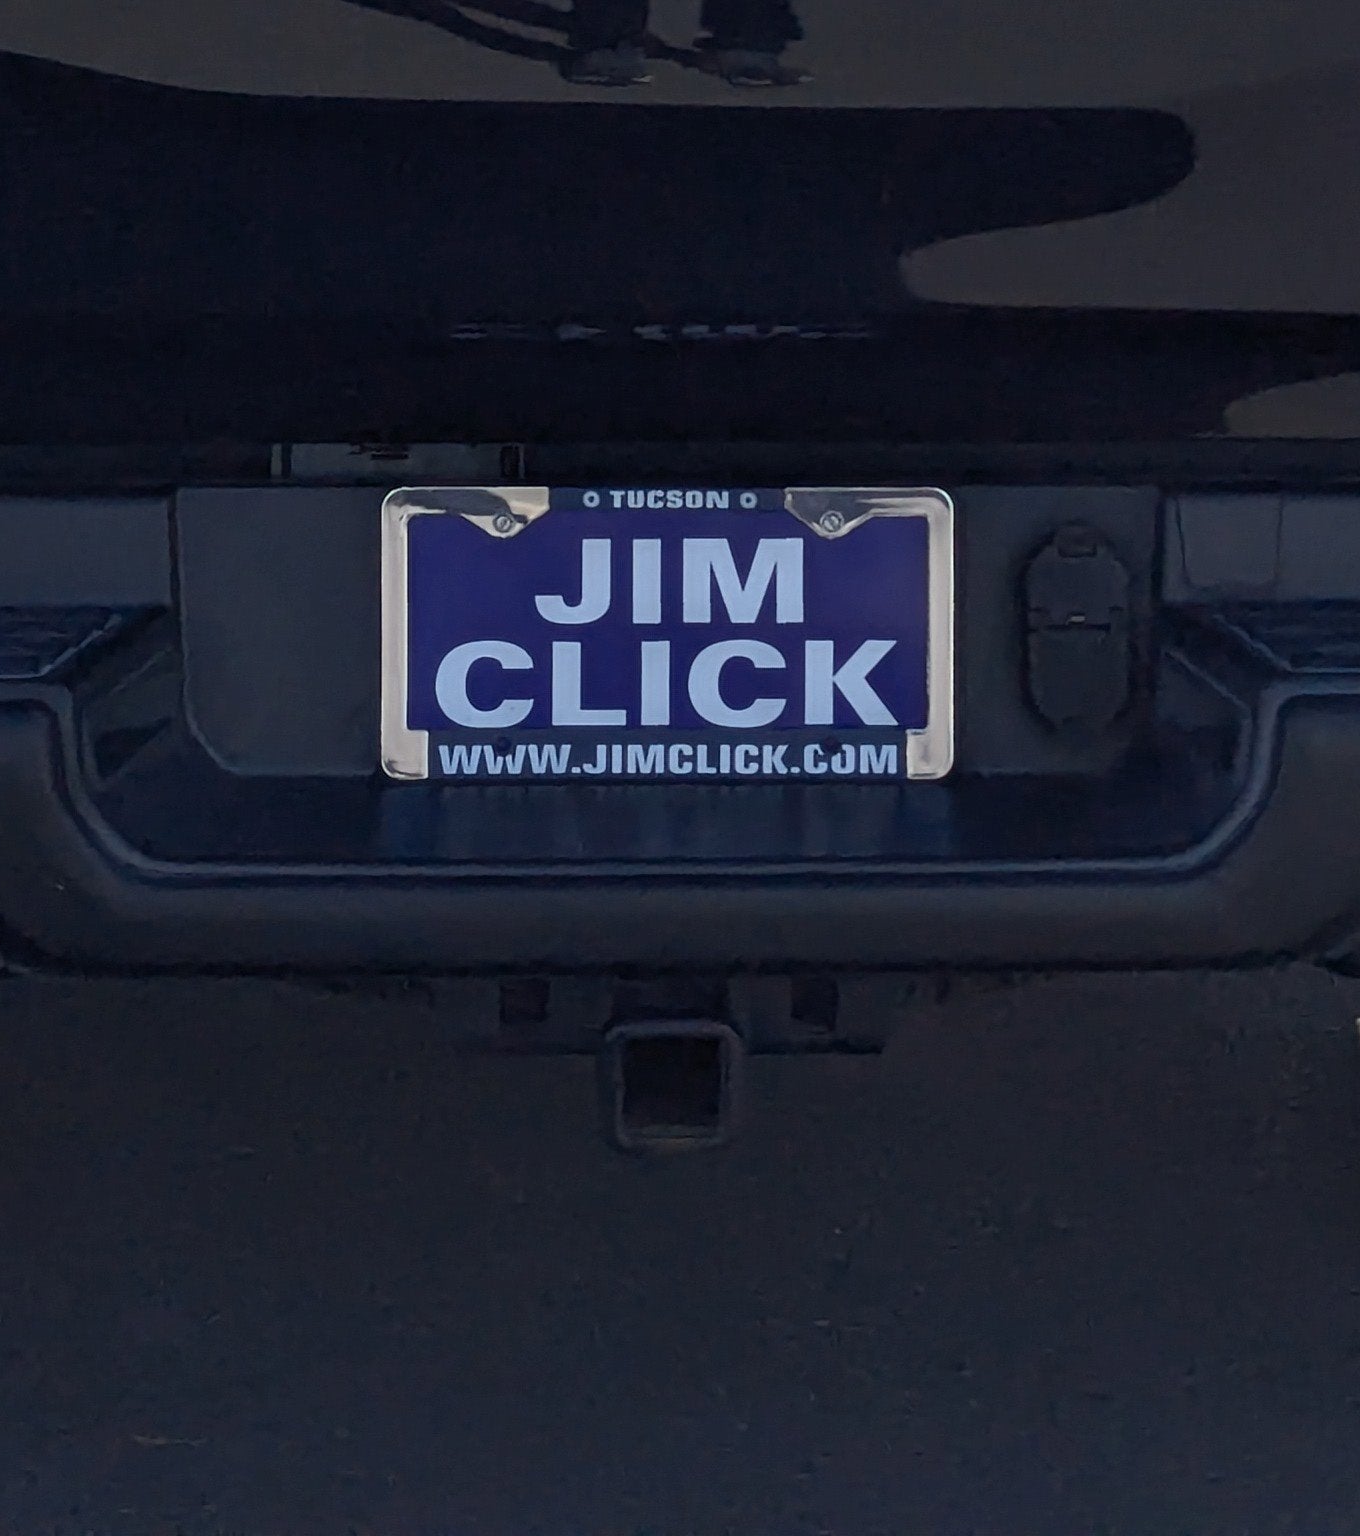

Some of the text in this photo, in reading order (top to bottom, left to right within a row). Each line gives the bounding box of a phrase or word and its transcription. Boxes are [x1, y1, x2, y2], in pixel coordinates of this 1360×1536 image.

[609, 489, 730, 510] TUCSON
[534, 537, 805, 625] JIM
[435, 639, 899, 728] CLICK
[438, 743, 899, 776] WWW.JIMCLICK.COM
